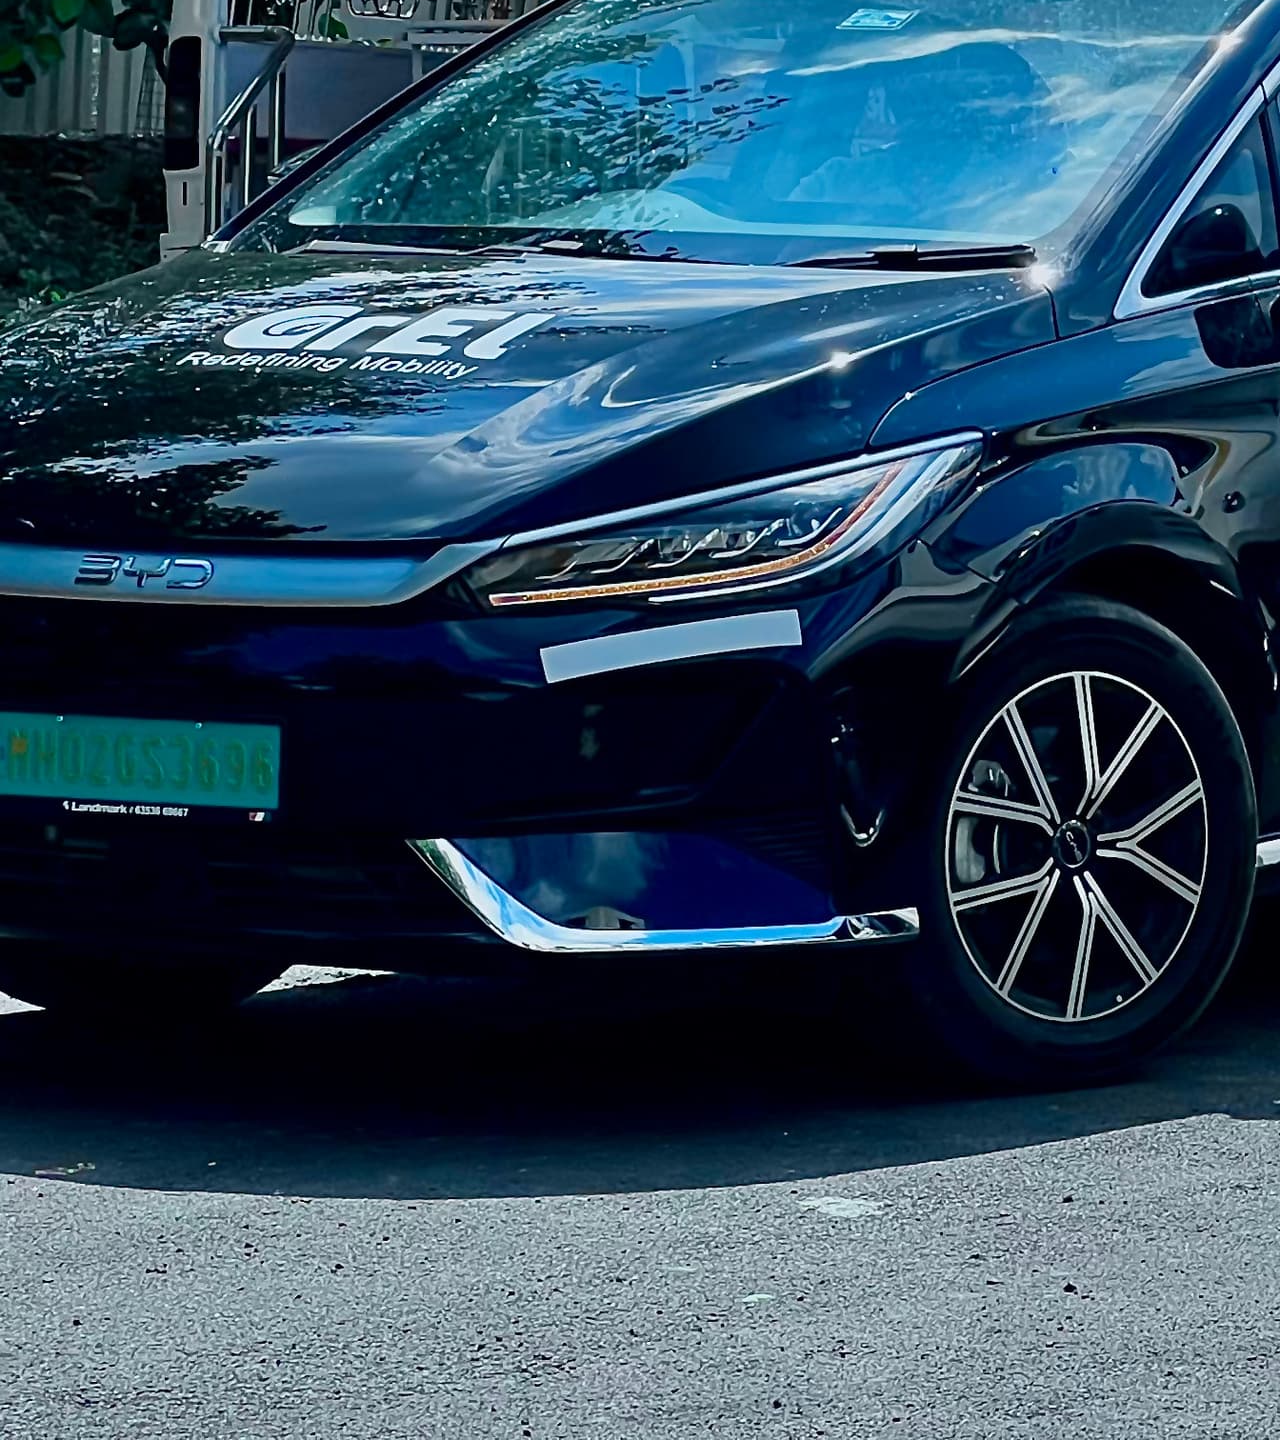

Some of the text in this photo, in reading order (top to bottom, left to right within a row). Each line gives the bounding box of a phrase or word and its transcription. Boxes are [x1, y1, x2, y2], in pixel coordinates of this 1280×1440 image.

[176, 351, 479, 380] Redefining Mobility
[74, 554, 215, 589] BYD
